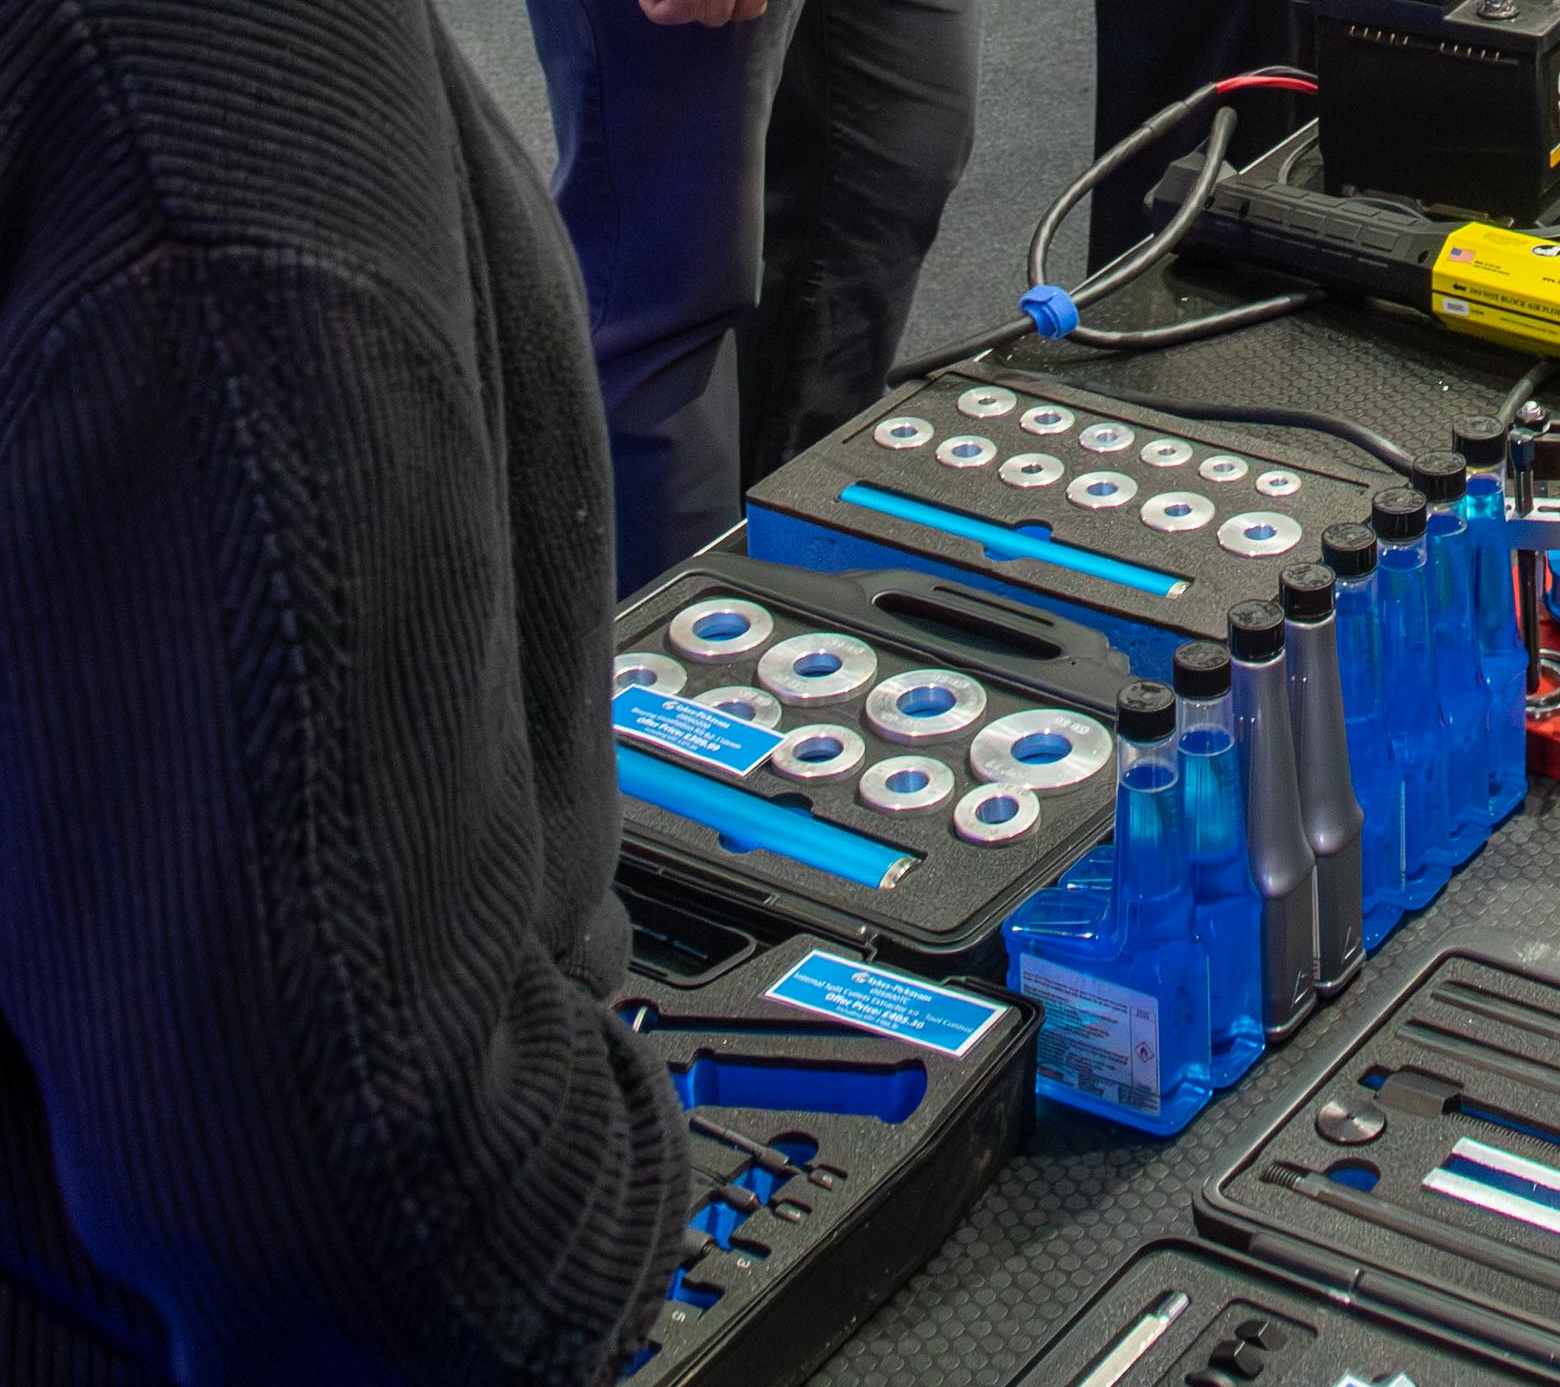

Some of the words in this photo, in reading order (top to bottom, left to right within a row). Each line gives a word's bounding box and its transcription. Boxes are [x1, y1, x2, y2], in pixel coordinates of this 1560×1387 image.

[1501, 294, 1527, 310] BLOCK
[1527, 300, 1541, 312] AIR
[824, 992, 853, 1009] Offer
[852, 999, 880, 1016] Price:
